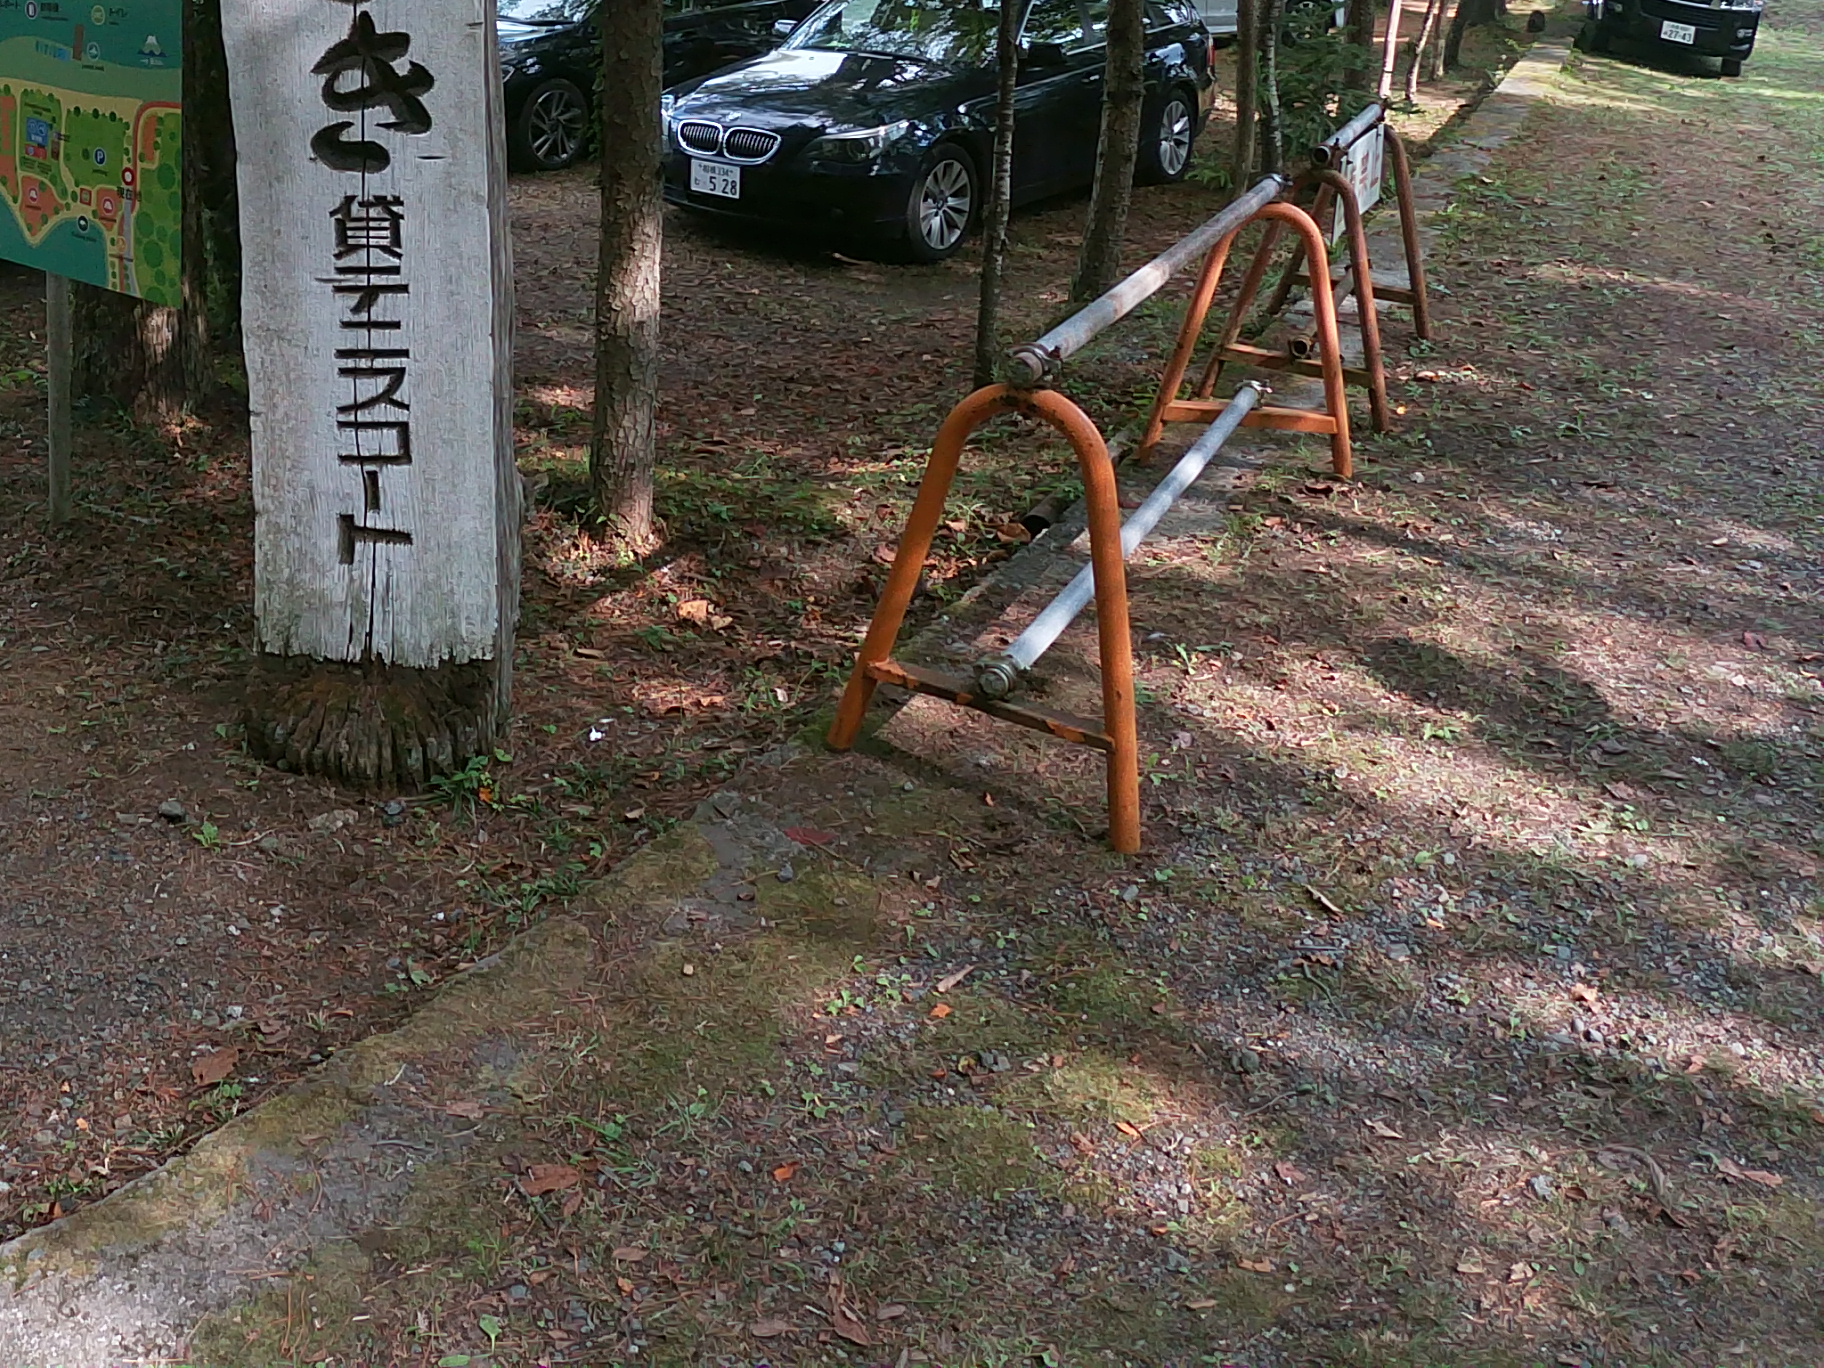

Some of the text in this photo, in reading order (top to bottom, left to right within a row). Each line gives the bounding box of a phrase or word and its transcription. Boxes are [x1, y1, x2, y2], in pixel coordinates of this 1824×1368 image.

[329, 194, 413, 565] 貸テニスコート
